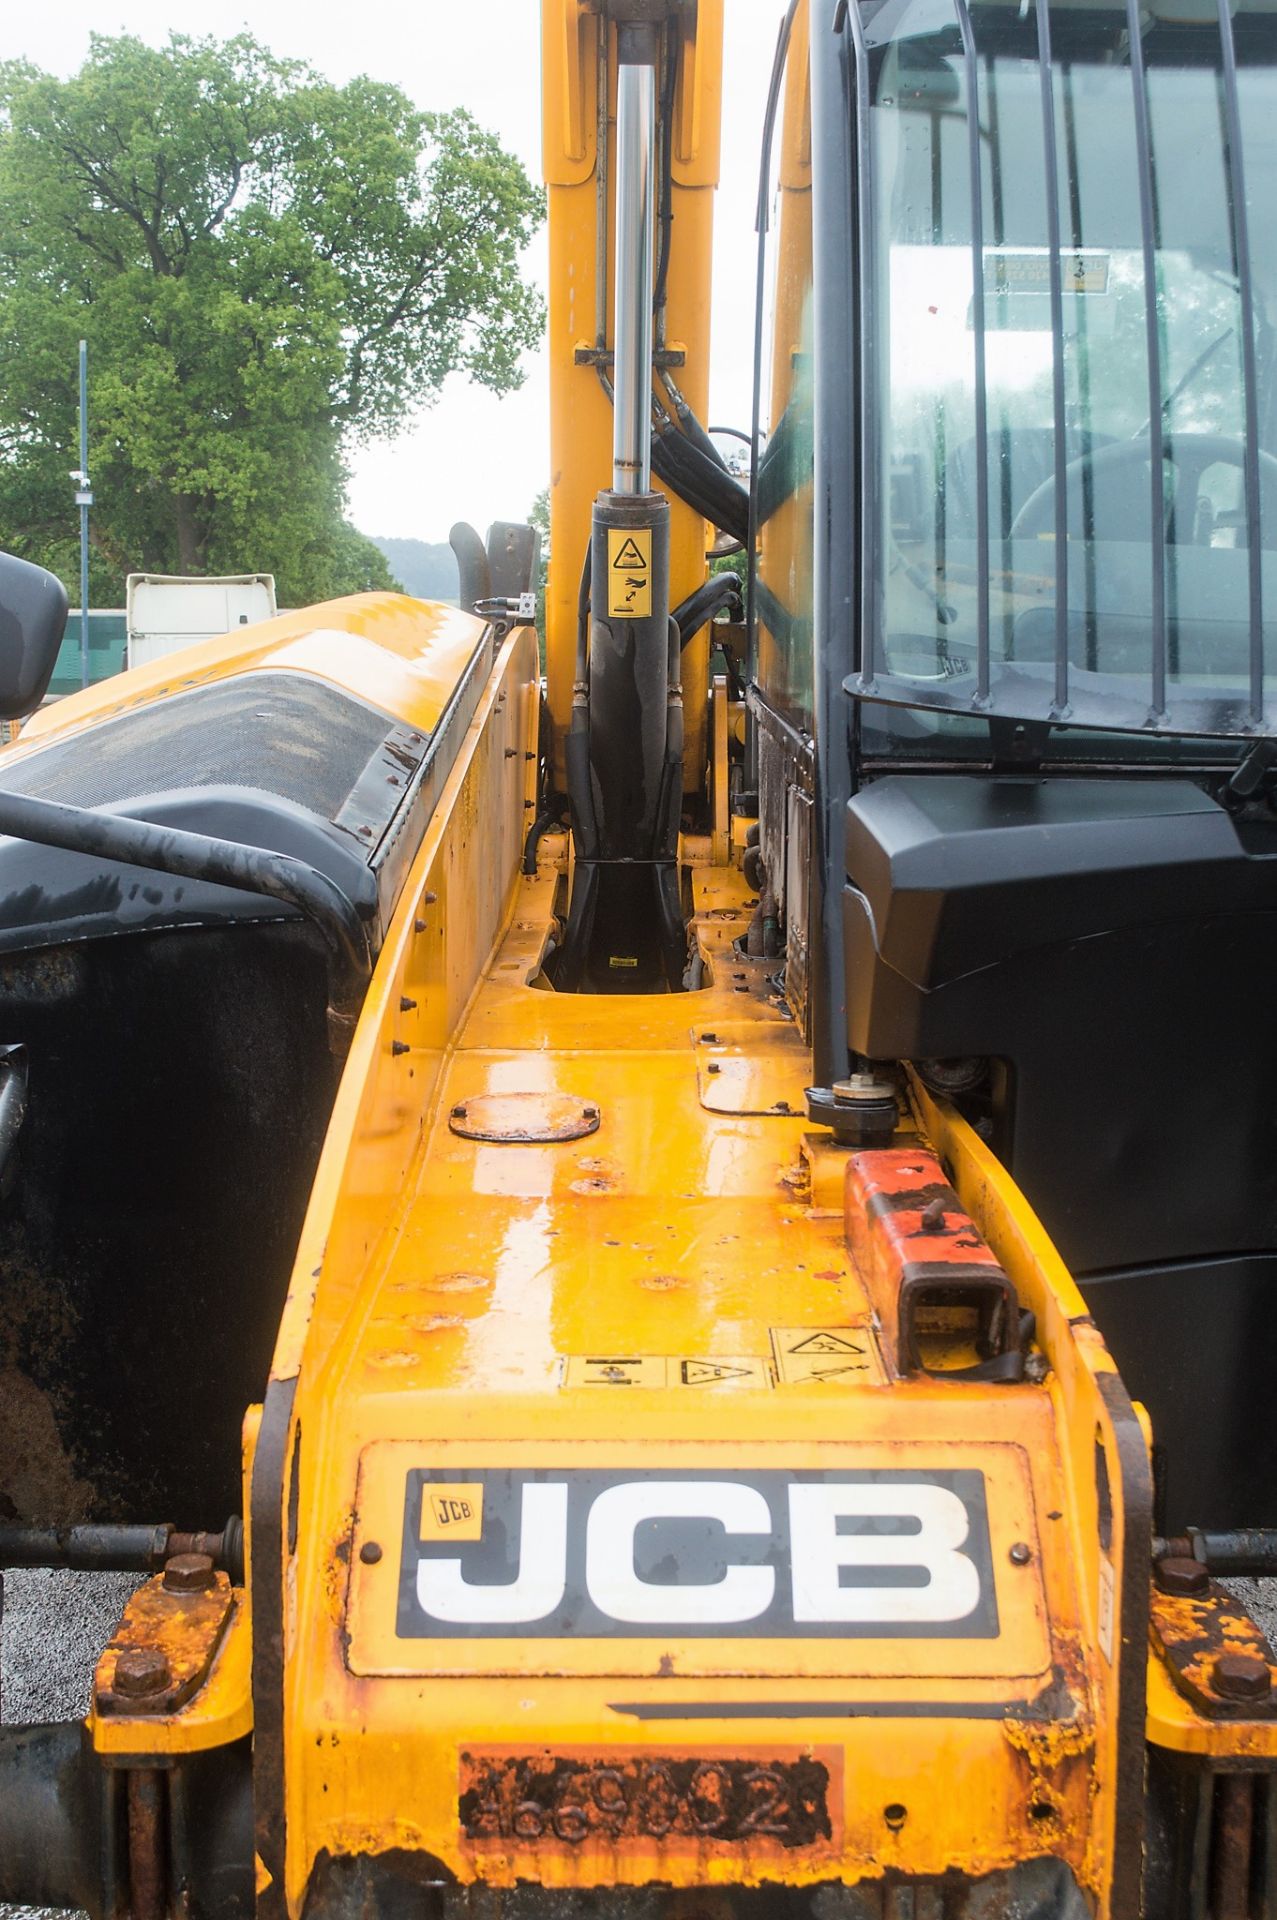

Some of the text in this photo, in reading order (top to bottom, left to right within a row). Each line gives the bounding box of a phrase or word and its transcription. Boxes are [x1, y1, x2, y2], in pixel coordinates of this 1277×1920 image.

[944, 656, 970, 676] JCB
[438, 1498, 471, 1524] JCB
[416, 1481, 981, 1624] JCB
